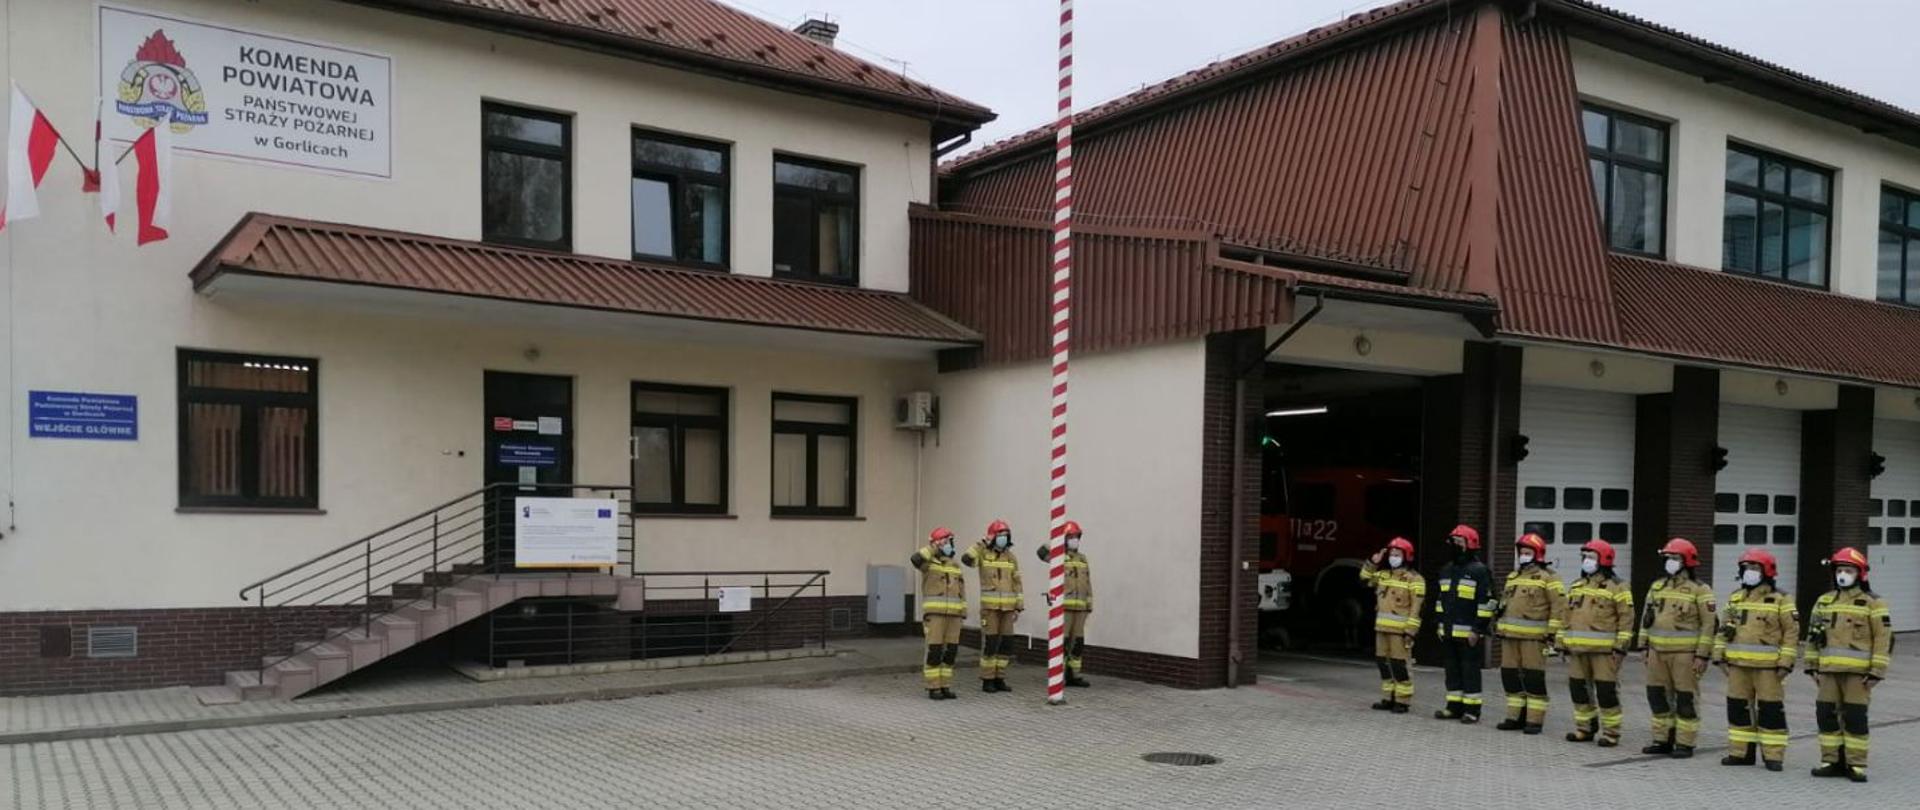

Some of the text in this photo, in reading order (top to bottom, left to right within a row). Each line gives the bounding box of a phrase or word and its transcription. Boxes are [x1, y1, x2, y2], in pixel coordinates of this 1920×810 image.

[240, 45, 359, 83] KOMENDA
[223, 66, 375, 107] POWIATOWA
[225, 108, 374, 142] STRAŻY POŻARNEJ
[243, 94, 358, 124] PAŃSTWOWEJ
[254, 136, 349, 159] w Gorlicach
[34, 422, 132, 435] WEJŚCIE GŁÓWNE
